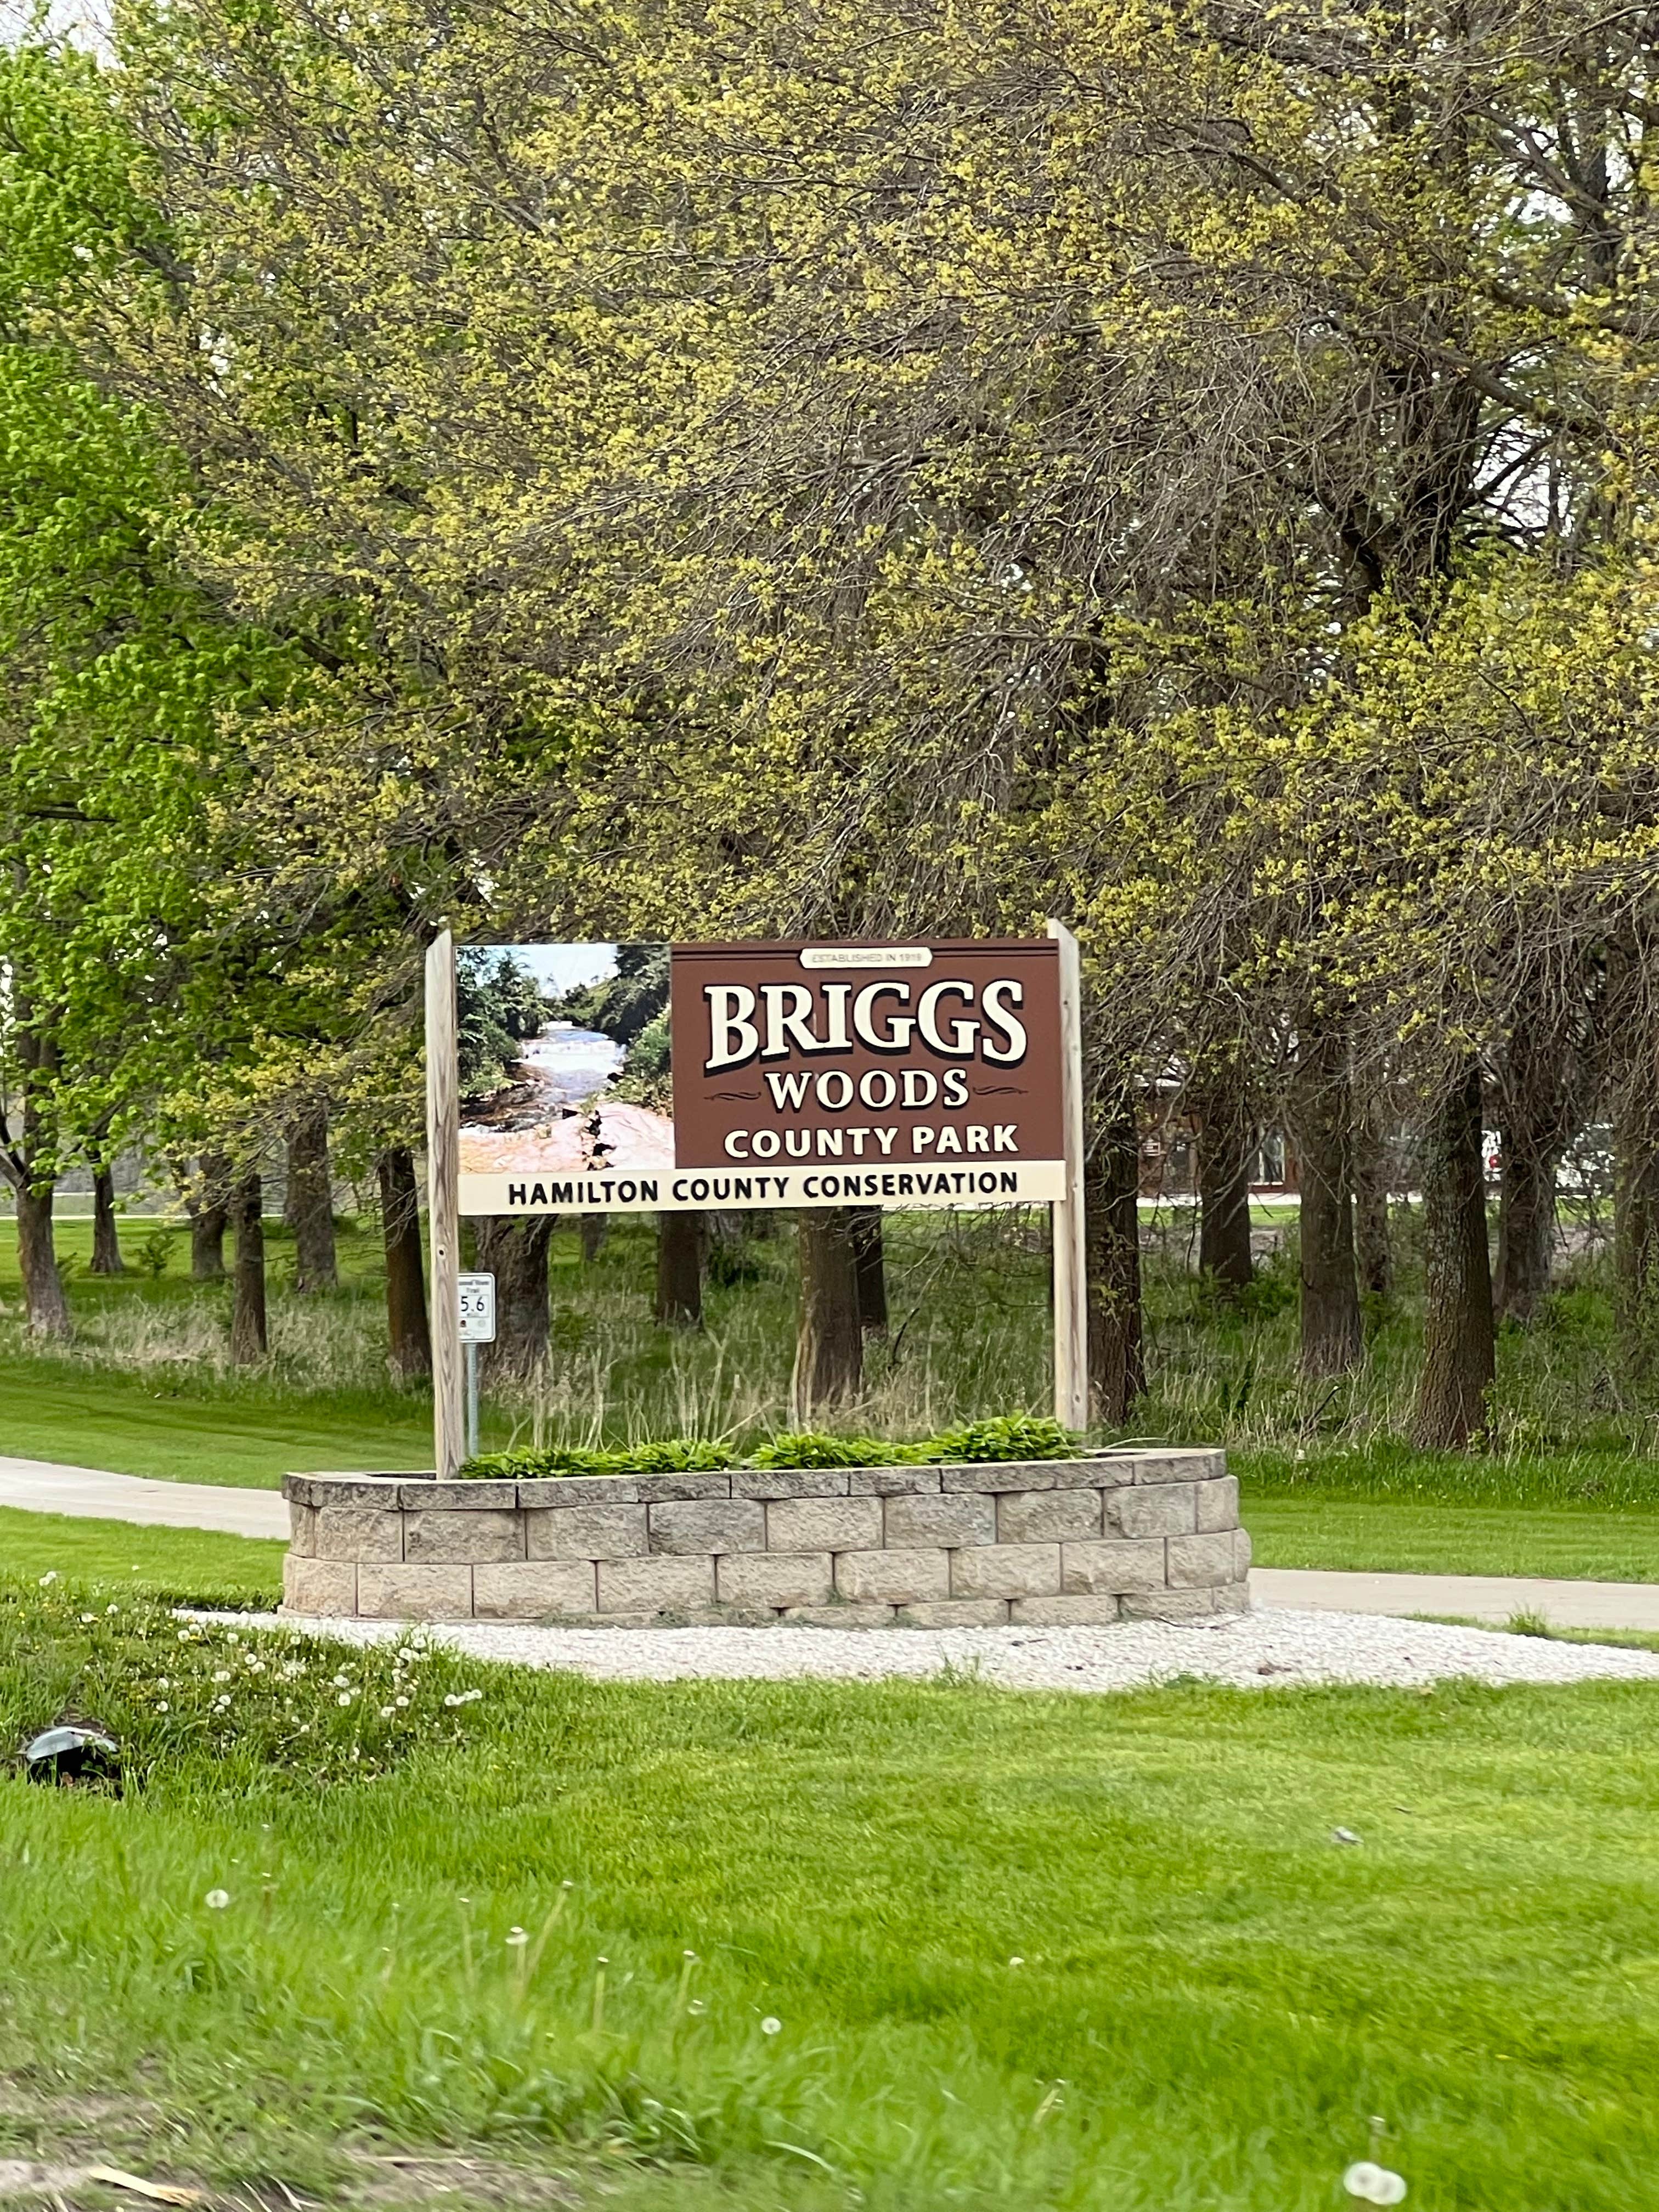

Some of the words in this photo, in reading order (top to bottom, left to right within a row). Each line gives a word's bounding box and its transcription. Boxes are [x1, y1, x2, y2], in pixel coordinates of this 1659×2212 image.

[812, 953, 883, 963] ESTABLISHED
[886, 953, 896, 962] IN
[703, 980, 1028, 1076] BRIGGS
[765, 1068, 969, 1113] WOODS
[724, 1127, 898, 1158] COUNTY
[912, 1124, 1019, 1153] PARK
[509, 1180, 658, 1206] HAMILTON
[672, 1177, 790, 1202] COUNTY
[803, 1172, 1018, 1198] CONSERVATION
